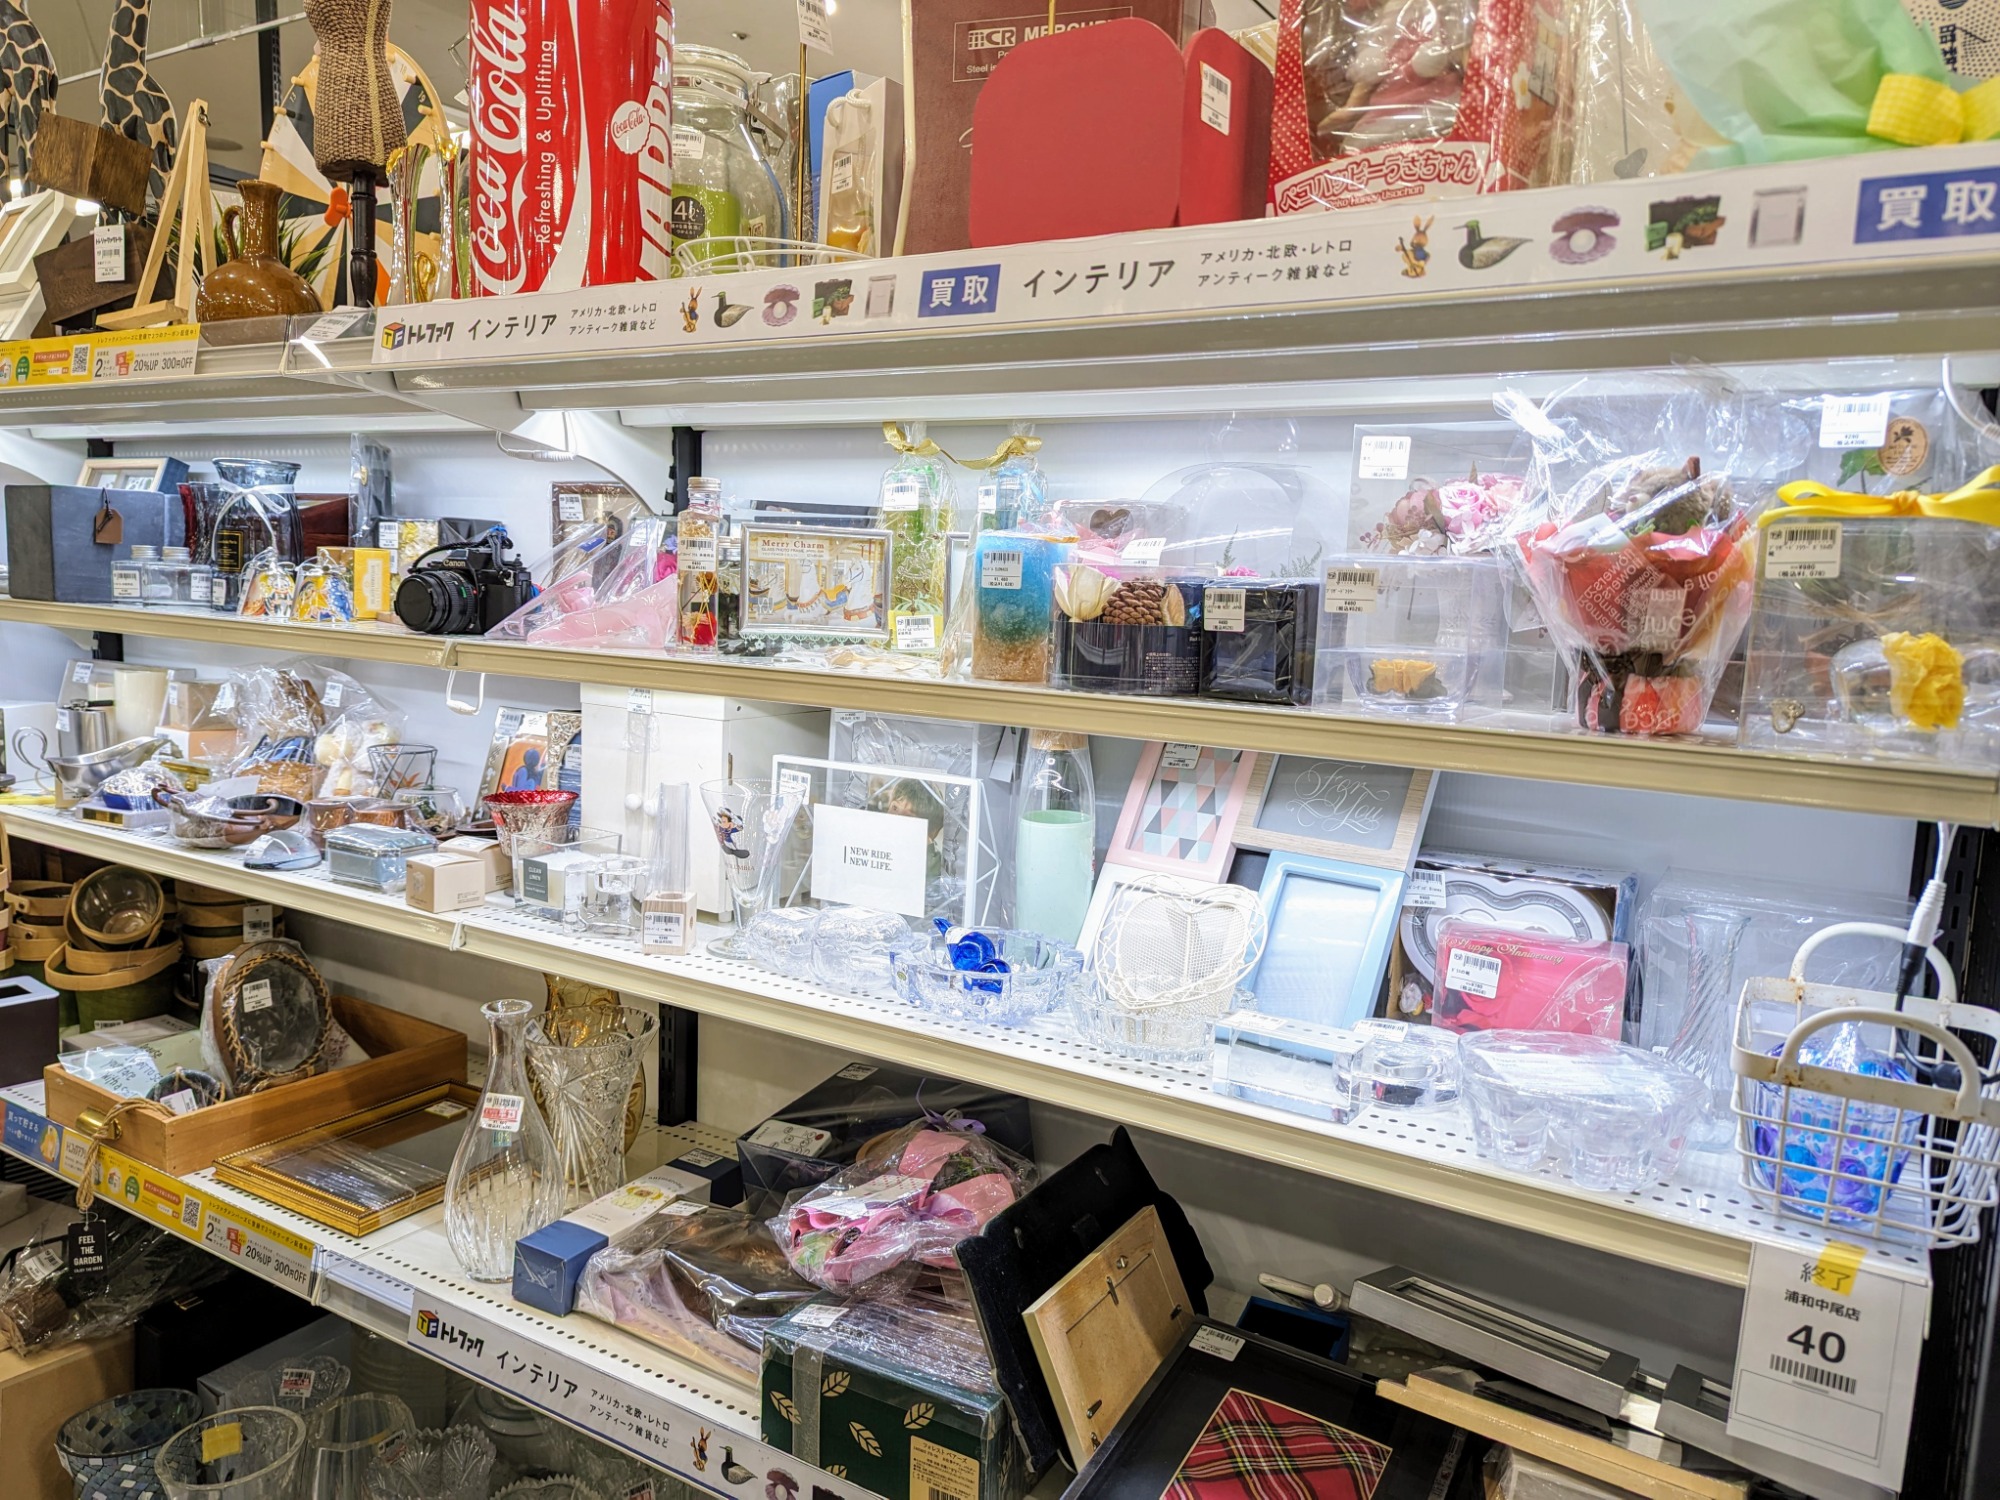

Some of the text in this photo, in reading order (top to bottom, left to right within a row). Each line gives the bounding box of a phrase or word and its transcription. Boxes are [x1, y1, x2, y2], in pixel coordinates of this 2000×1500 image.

[966, 65, 989, 74] Steel
[535, 40, 555, 244] Refreshing & Uplifting
[1877, 180, 1998, 231] 買取
[1200, 238, 1352, 265] アメリカ・北欧・レトロ
[928, 258, 1176, 308] 買取 インテリア
[1198, 261, 1352, 288] アンティーク雑貨など
[570, 302, 657, 319] アメリカ・北欧・レトロ
[407, 321, 454, 345] トレファク
[467, 313, 558, 341] インテリア
[568, 318, 657, 337] アンティーク雑貨など
[133, 357, 159, 372] 20%UP
[161, 355, 193, 371] 300円OFF
[761, 540, 825, 549] Merry Charm
[443, 559, 466, 568] Canon
[1295, 761, 1391, 801] For
[849, 846, 893, 861] NEW RIDE.
[849, 857, 893, 872] NEW LIFE.
[1441, 935, 1565, 965] Happy Anniversary
[78, 1235, 96, 1245] FEEL
[80, 1246, 95, 1255] THE
[205, 1222, 307, 1285] 2 20%UP 300円OFF
[73, 1255, 103, 1266] GARDEN
[1800, 1262, 1852, 1291] 終了
[1784, 1288, 1862, 1322] 浦和中尾店
[1787, 1324, 1847, 1363] 40
[440, 1321, 485, 1358] トレファク
[496, 1350, 578, 1399] インテリア
[591, 1388, 670, 1432] アメリカ・北欧・レトロ
[588, 1404, 669, 1449] アンティーク雑貨など
